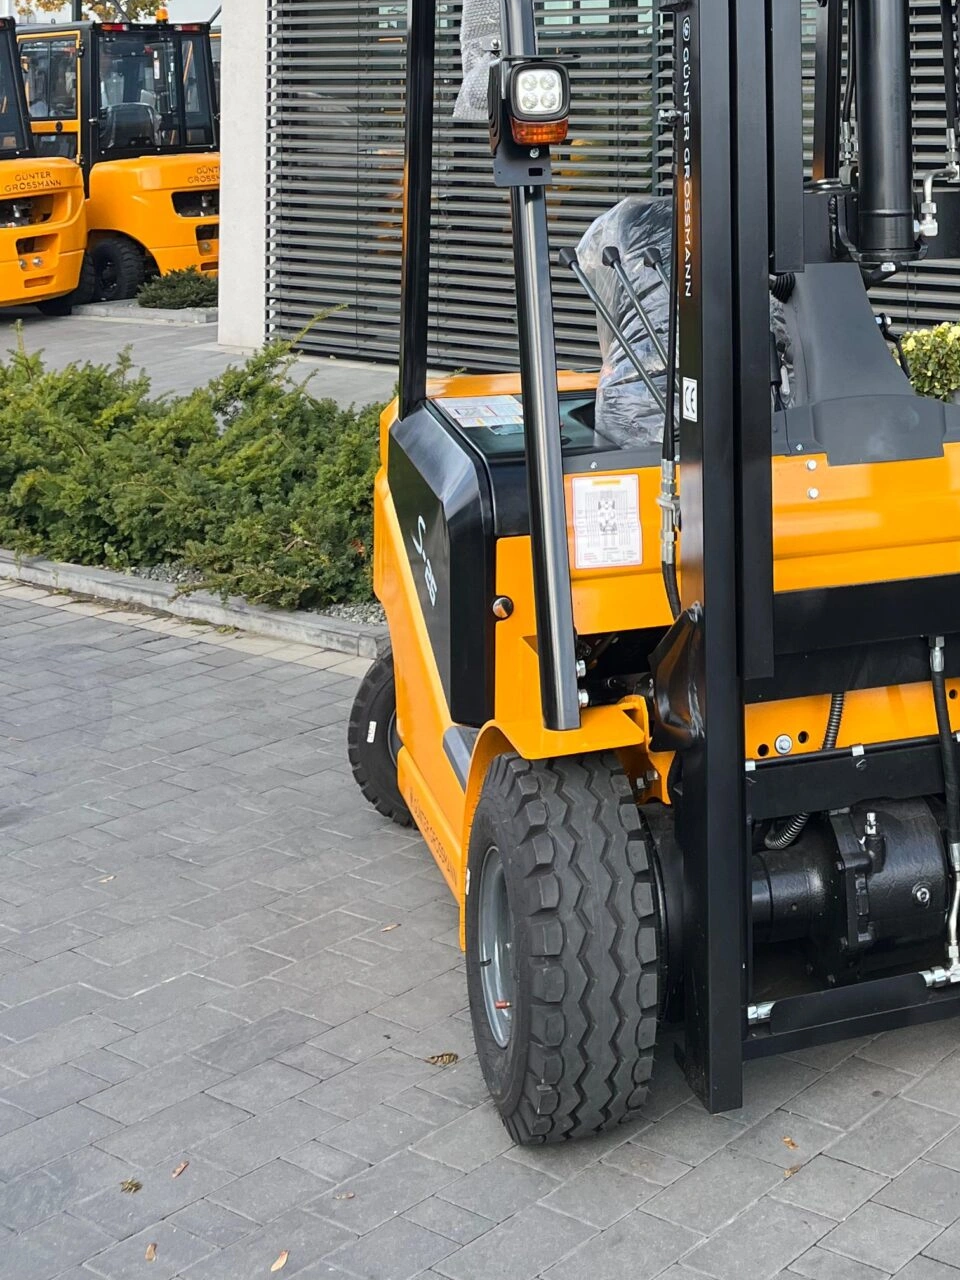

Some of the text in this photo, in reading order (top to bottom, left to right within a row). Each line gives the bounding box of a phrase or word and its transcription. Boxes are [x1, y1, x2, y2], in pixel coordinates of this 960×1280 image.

[4, 180, 61, 192] GROSSMANN
[683, 47, 692, 297] GÜNTER GROSSMANN
